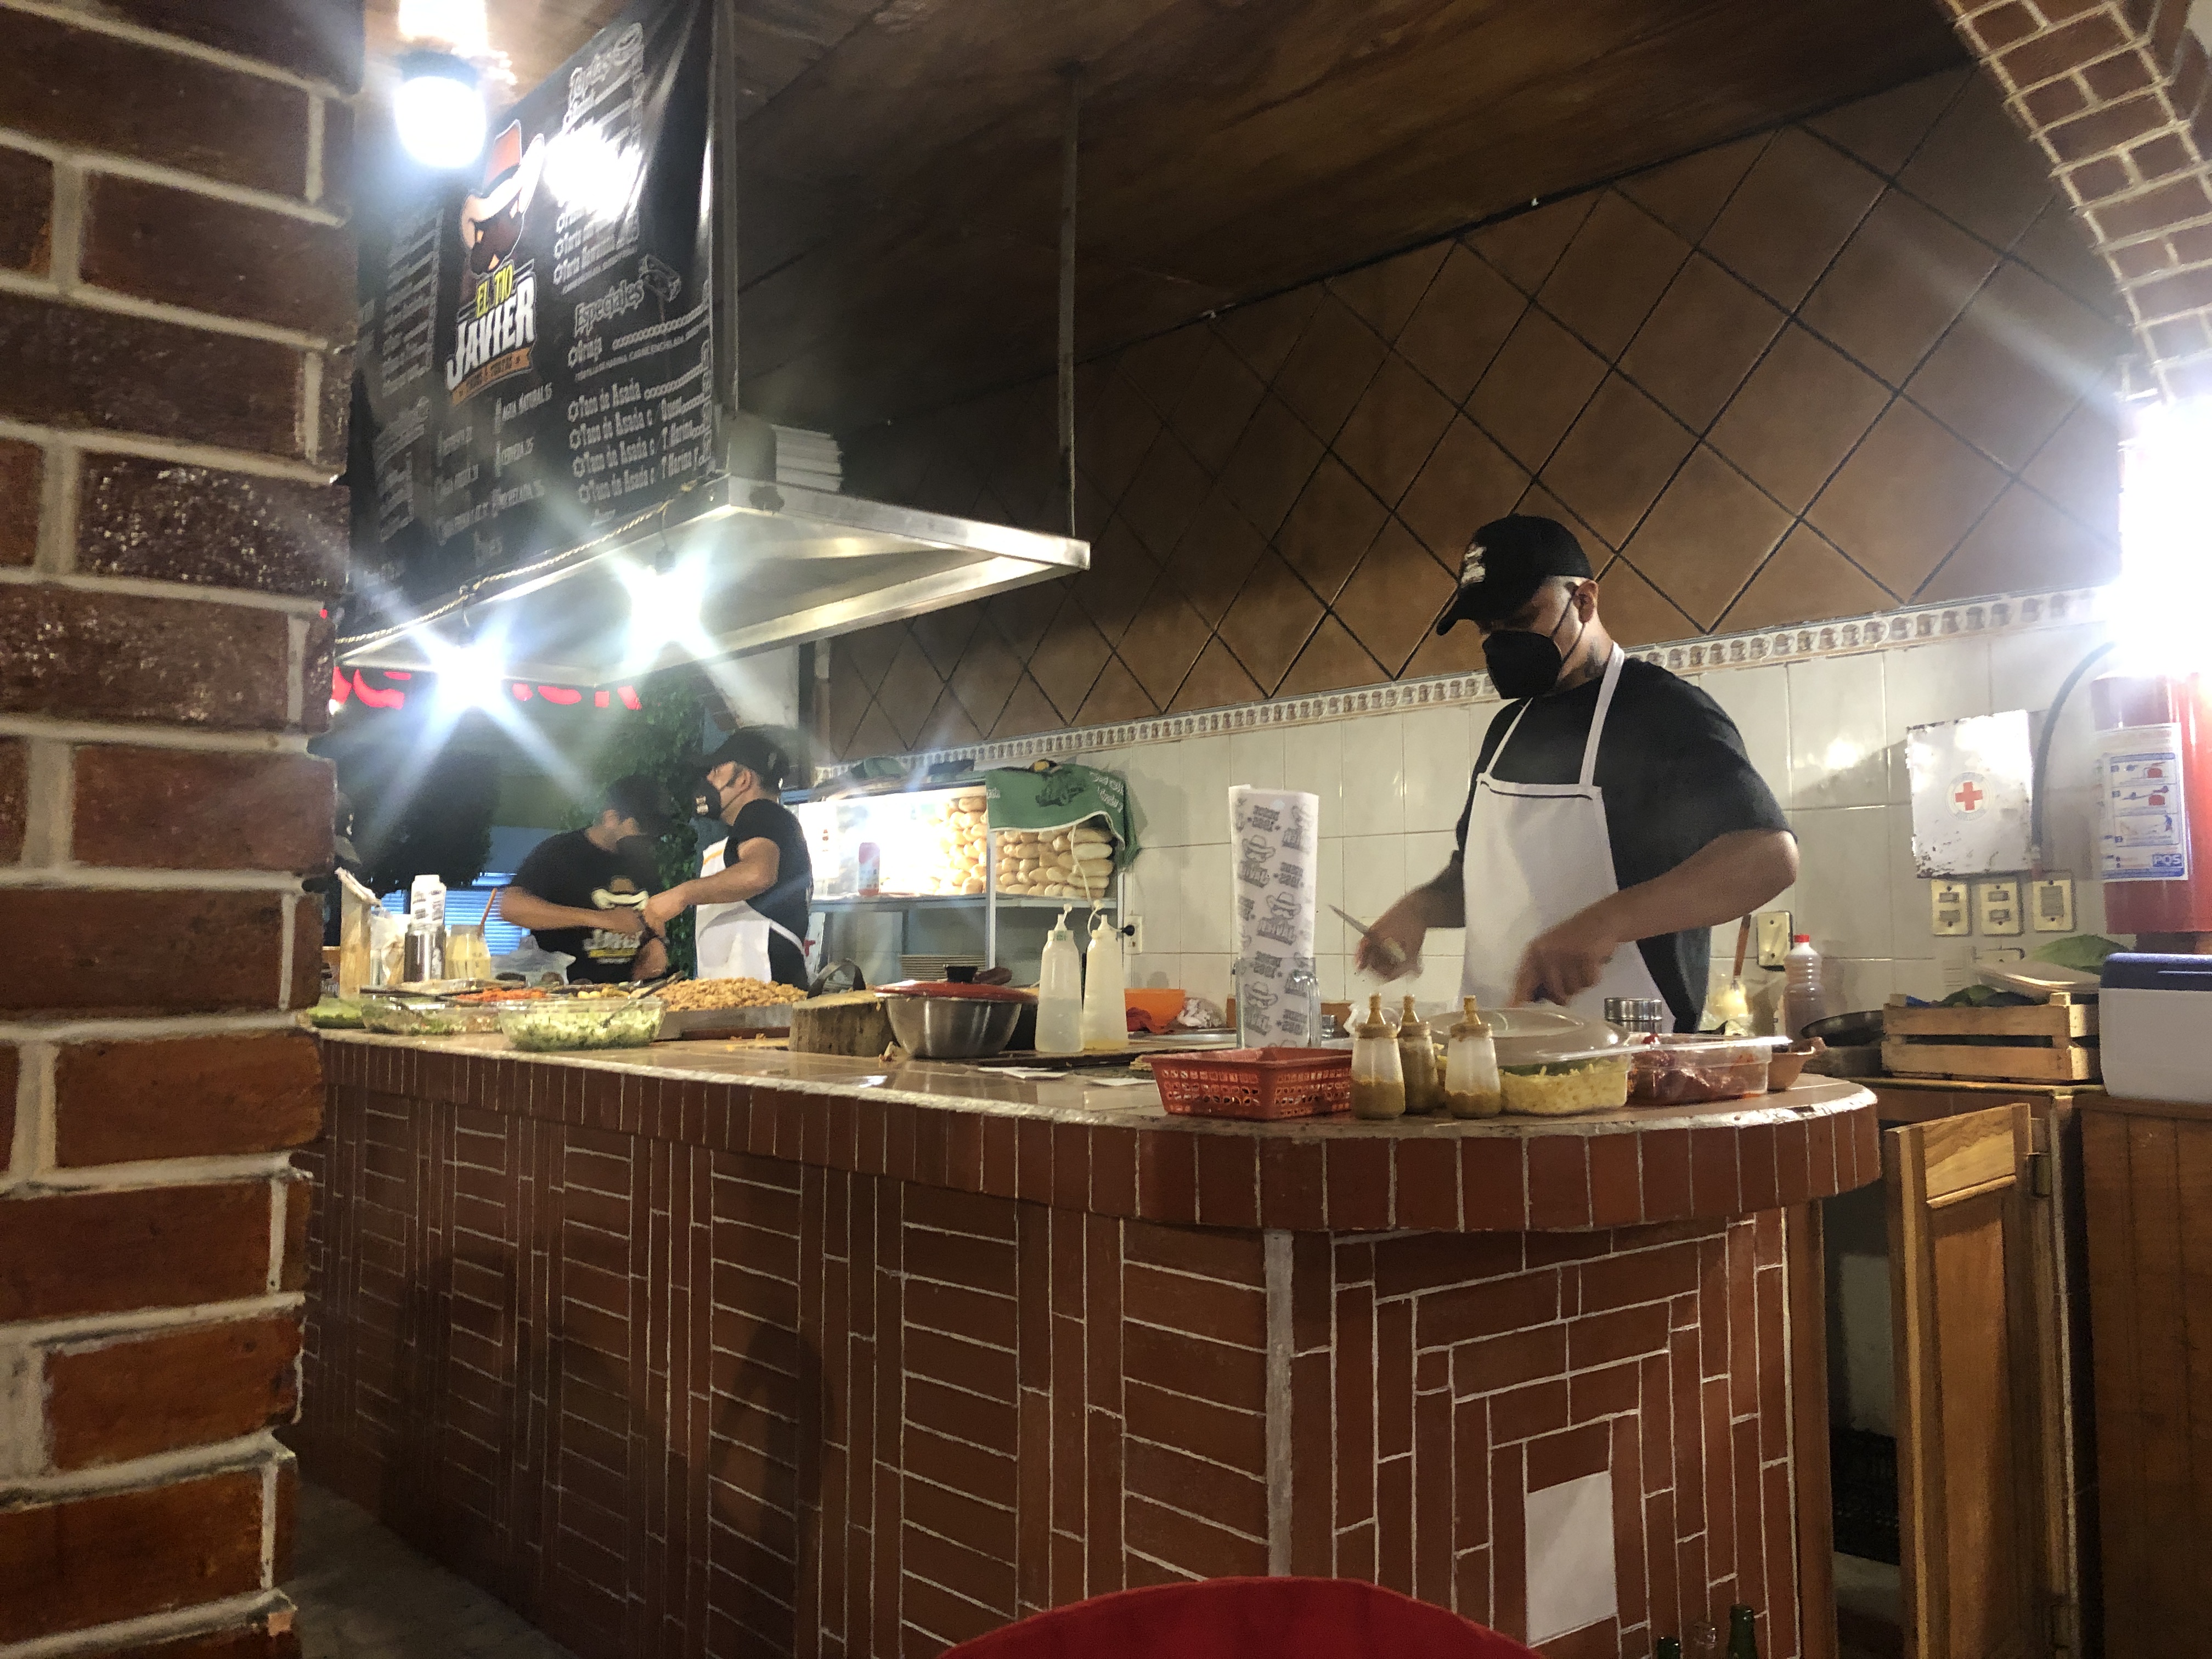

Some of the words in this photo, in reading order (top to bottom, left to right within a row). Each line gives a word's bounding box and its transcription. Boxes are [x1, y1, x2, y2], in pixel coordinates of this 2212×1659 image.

[476, 280, 489, 318] EL
[447, 276, 535, 391] JAVIER
[2153, 855, 2182, 866] PQS
